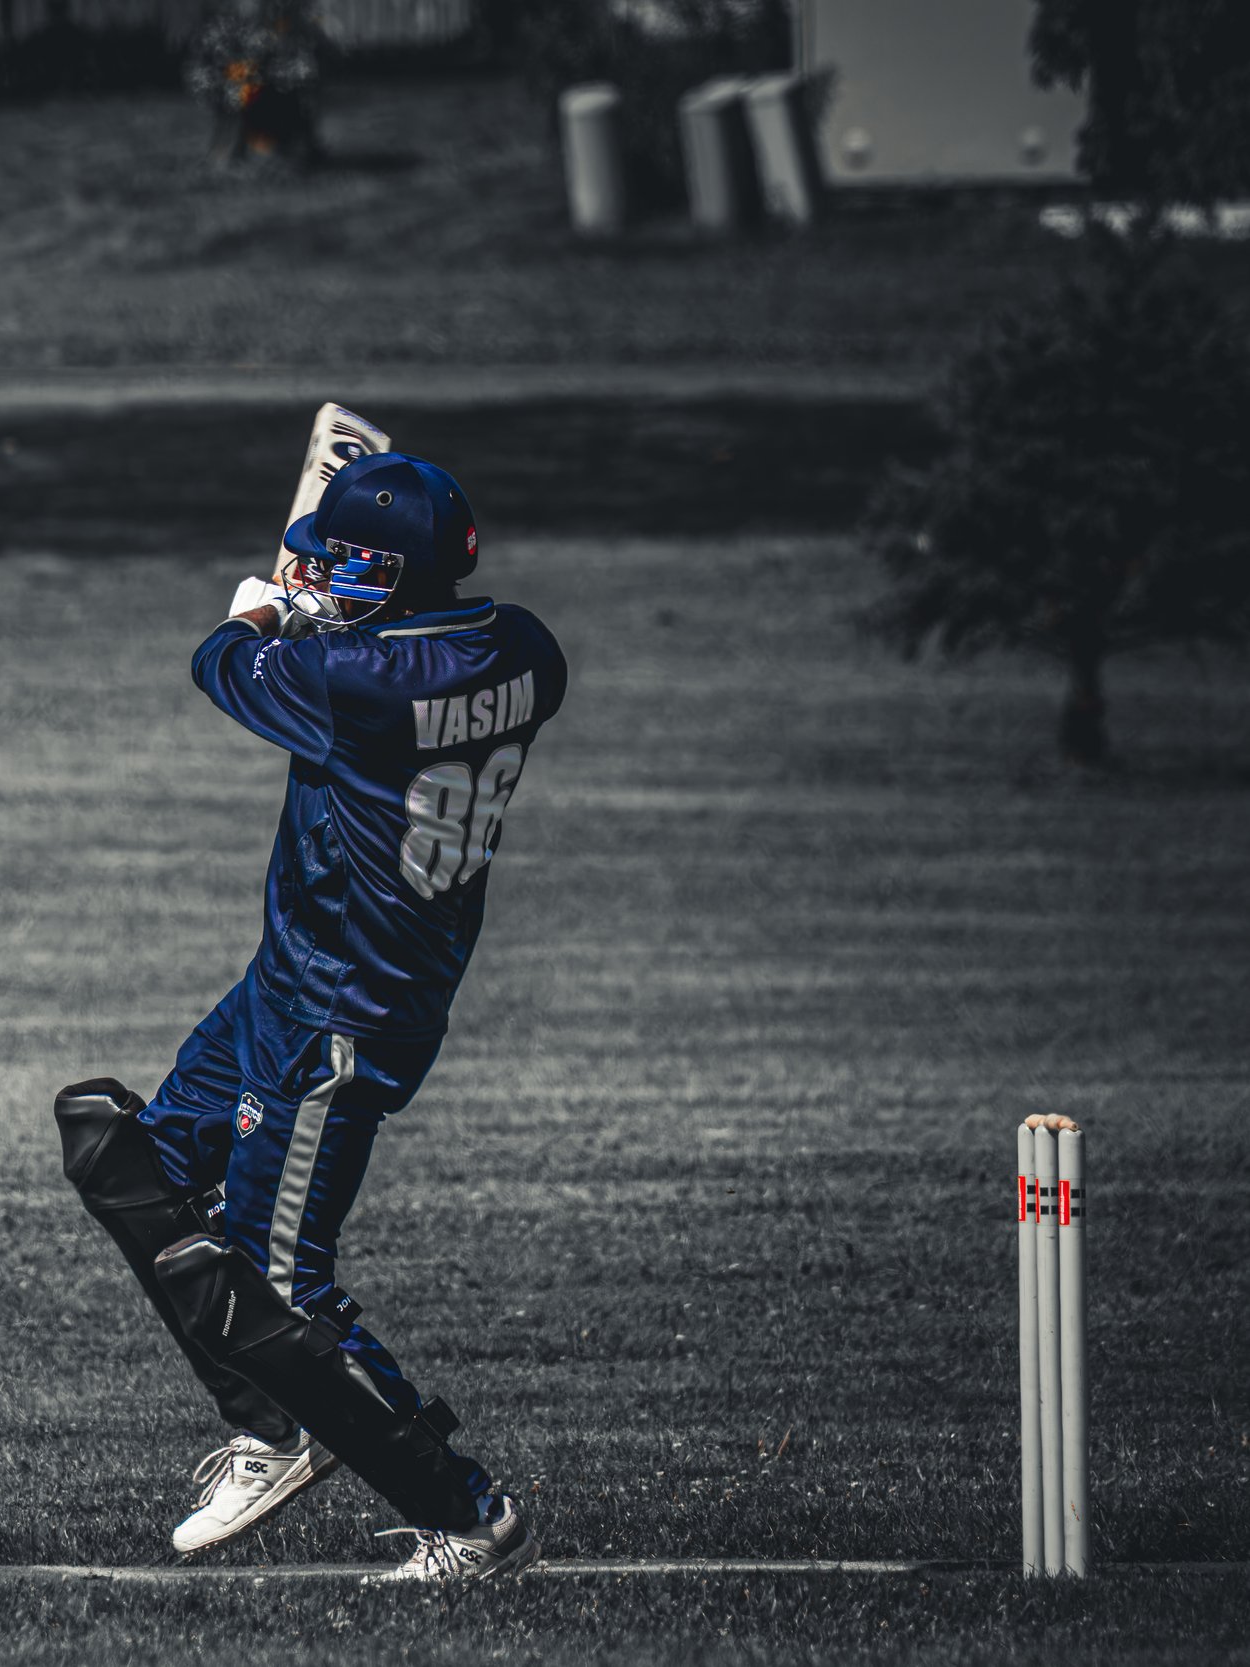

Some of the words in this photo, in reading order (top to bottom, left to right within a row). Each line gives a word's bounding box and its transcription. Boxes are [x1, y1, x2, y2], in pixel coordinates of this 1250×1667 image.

[412, 669, 535, 751] VASIM
[399, 743, 523, 901] 86
[245, 1460, 268, 1474] DSC
[459, 1547, 483, 1565] DSC
